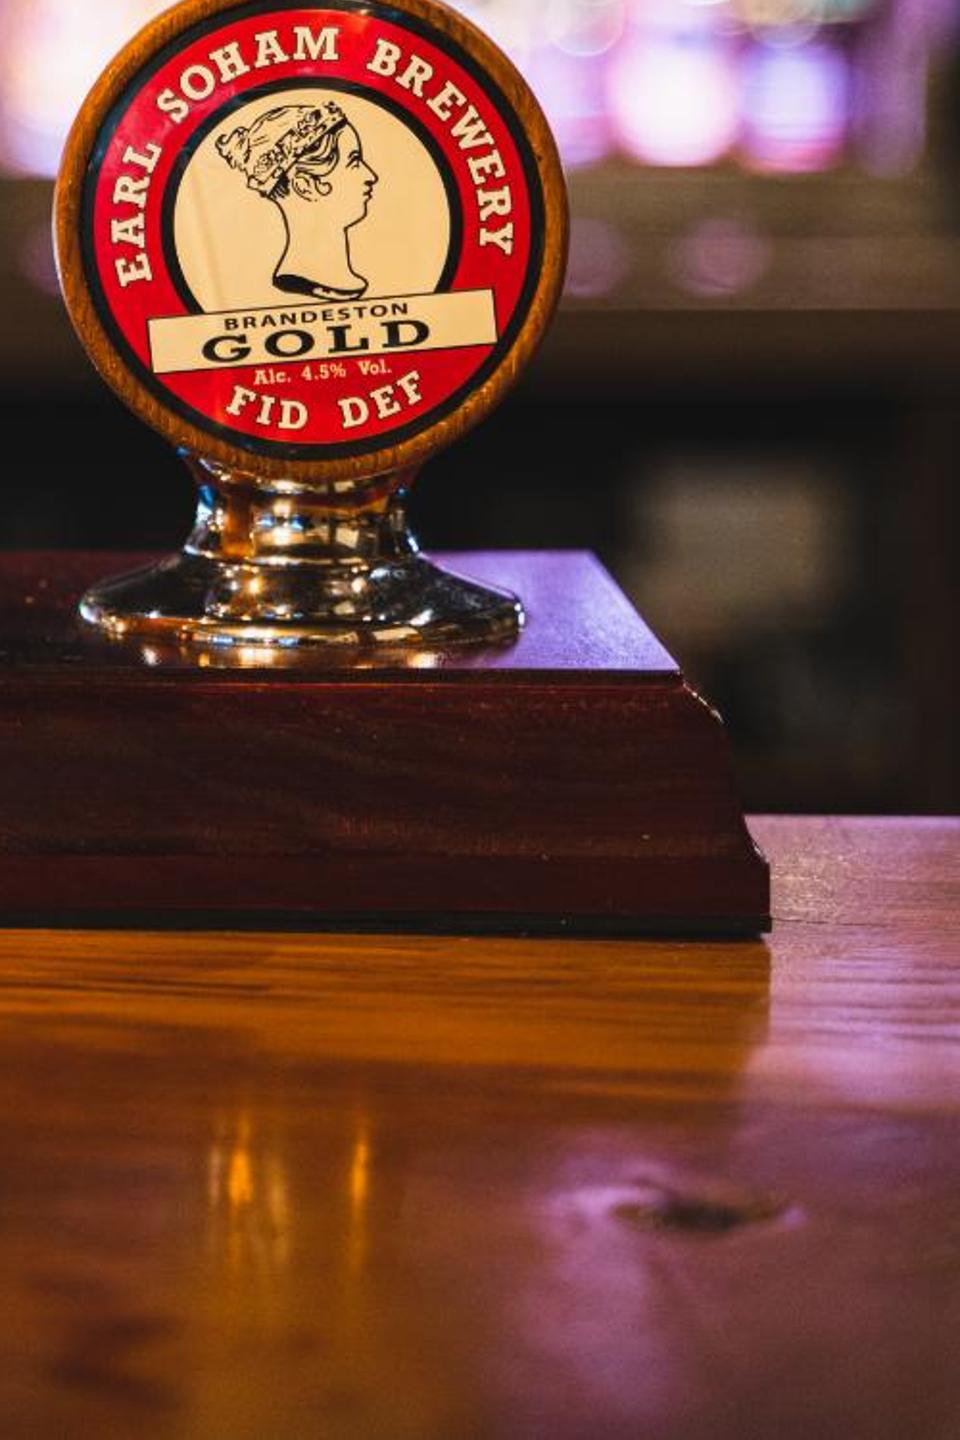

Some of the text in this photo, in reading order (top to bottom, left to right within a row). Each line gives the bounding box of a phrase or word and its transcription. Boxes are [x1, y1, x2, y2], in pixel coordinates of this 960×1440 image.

[110, 26, 515, 288] EARL SOHAM BREWERY
[224, 302, 409, 331] BRANDESTON
[201, 319, 430, 363] GOLD
[252, 359, 393, 386] Alc. 4.5% Vol.
[225, 370, 424, 430] FID DEF
